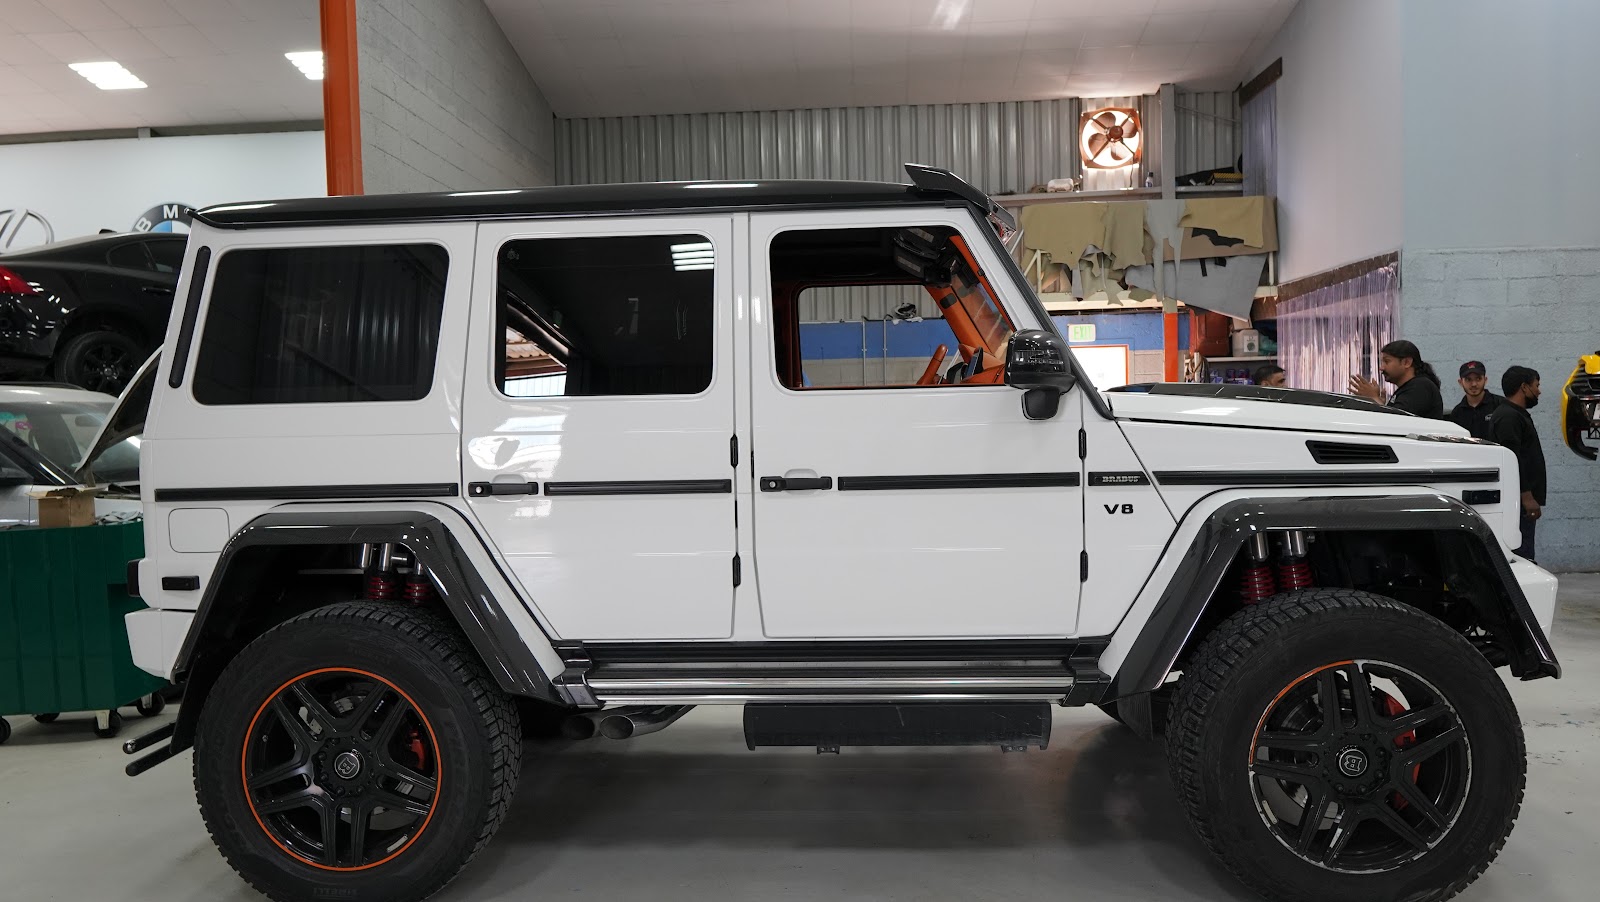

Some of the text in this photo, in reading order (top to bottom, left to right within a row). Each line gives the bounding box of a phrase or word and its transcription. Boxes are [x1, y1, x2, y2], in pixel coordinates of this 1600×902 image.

[1073, 325, 1092, 340] EXIT
[1102, 475, 1141, 483] BRABUS
[1103, 503, 1134, 515] V8
